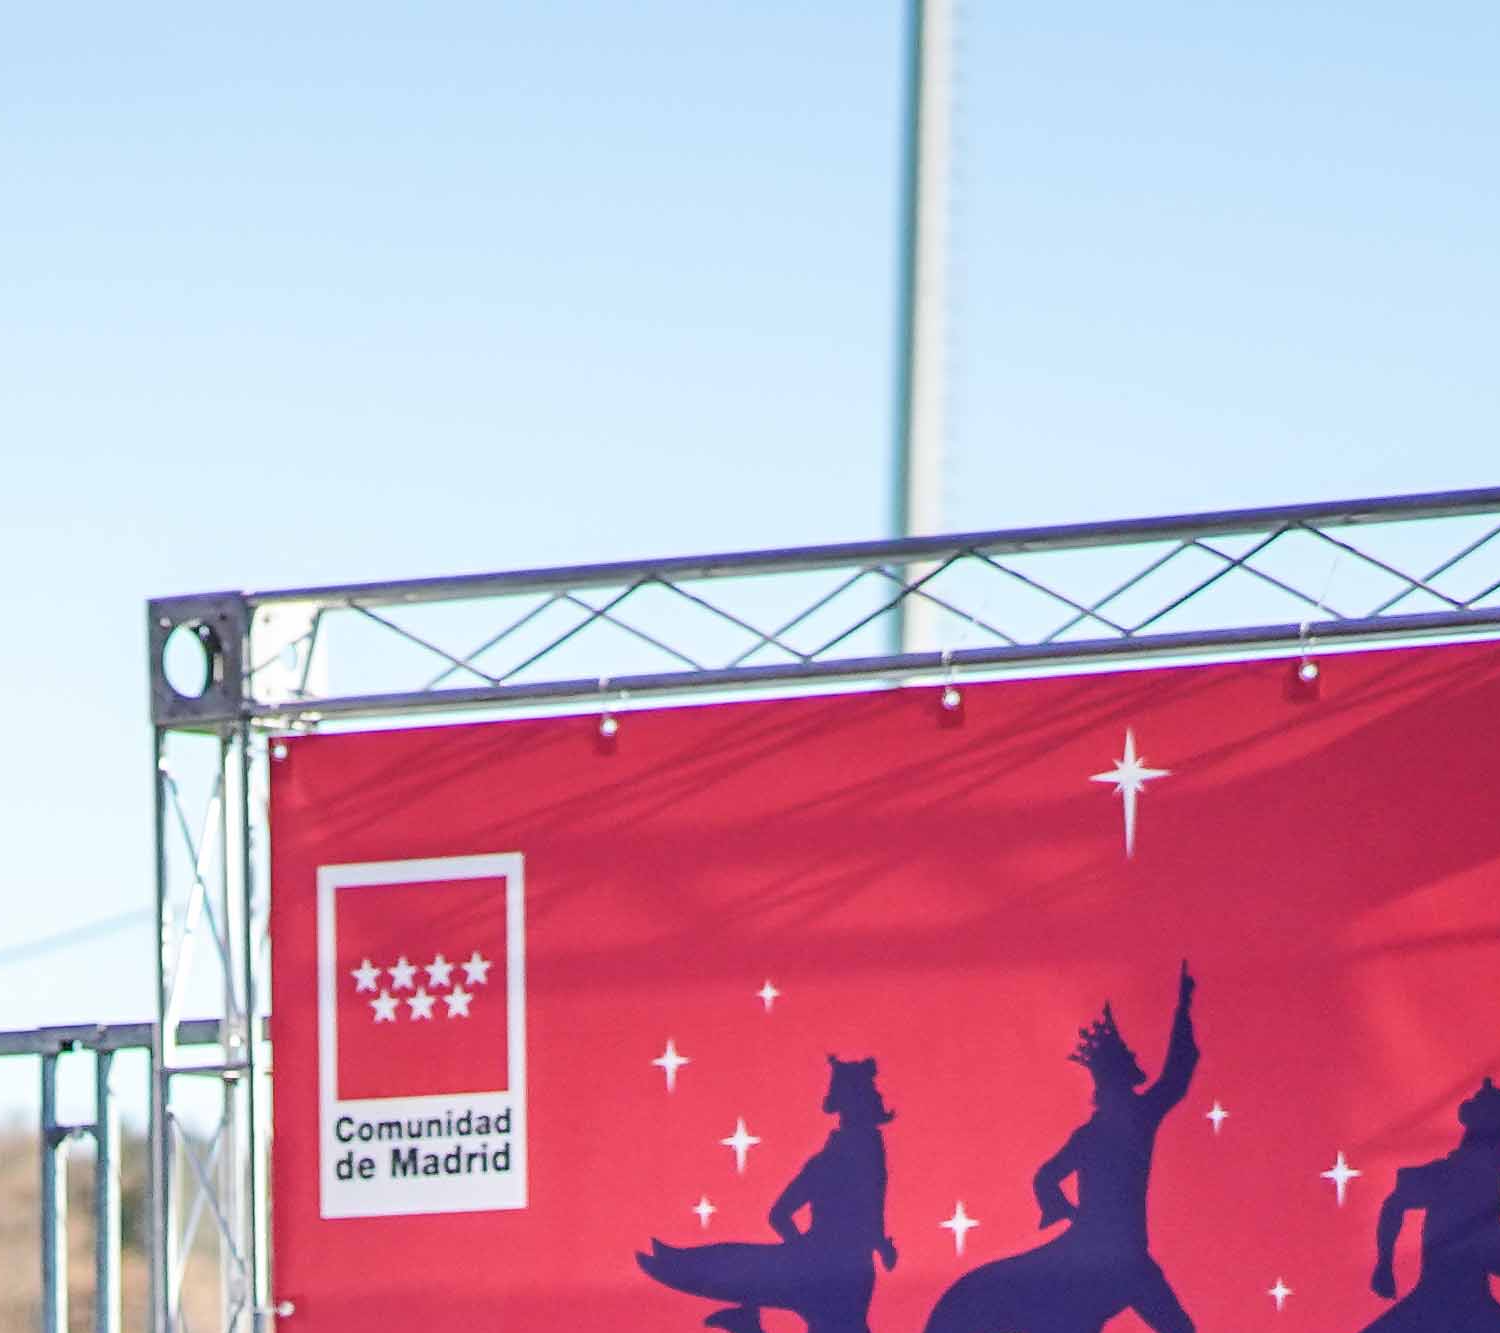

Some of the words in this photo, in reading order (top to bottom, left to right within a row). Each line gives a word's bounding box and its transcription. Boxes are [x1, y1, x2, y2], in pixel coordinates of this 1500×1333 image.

[336, 1107, 512, 1142] Comunidad
[336, 1151, 376, 1180] de
[390, 1142, 511, 1178] Madrid
